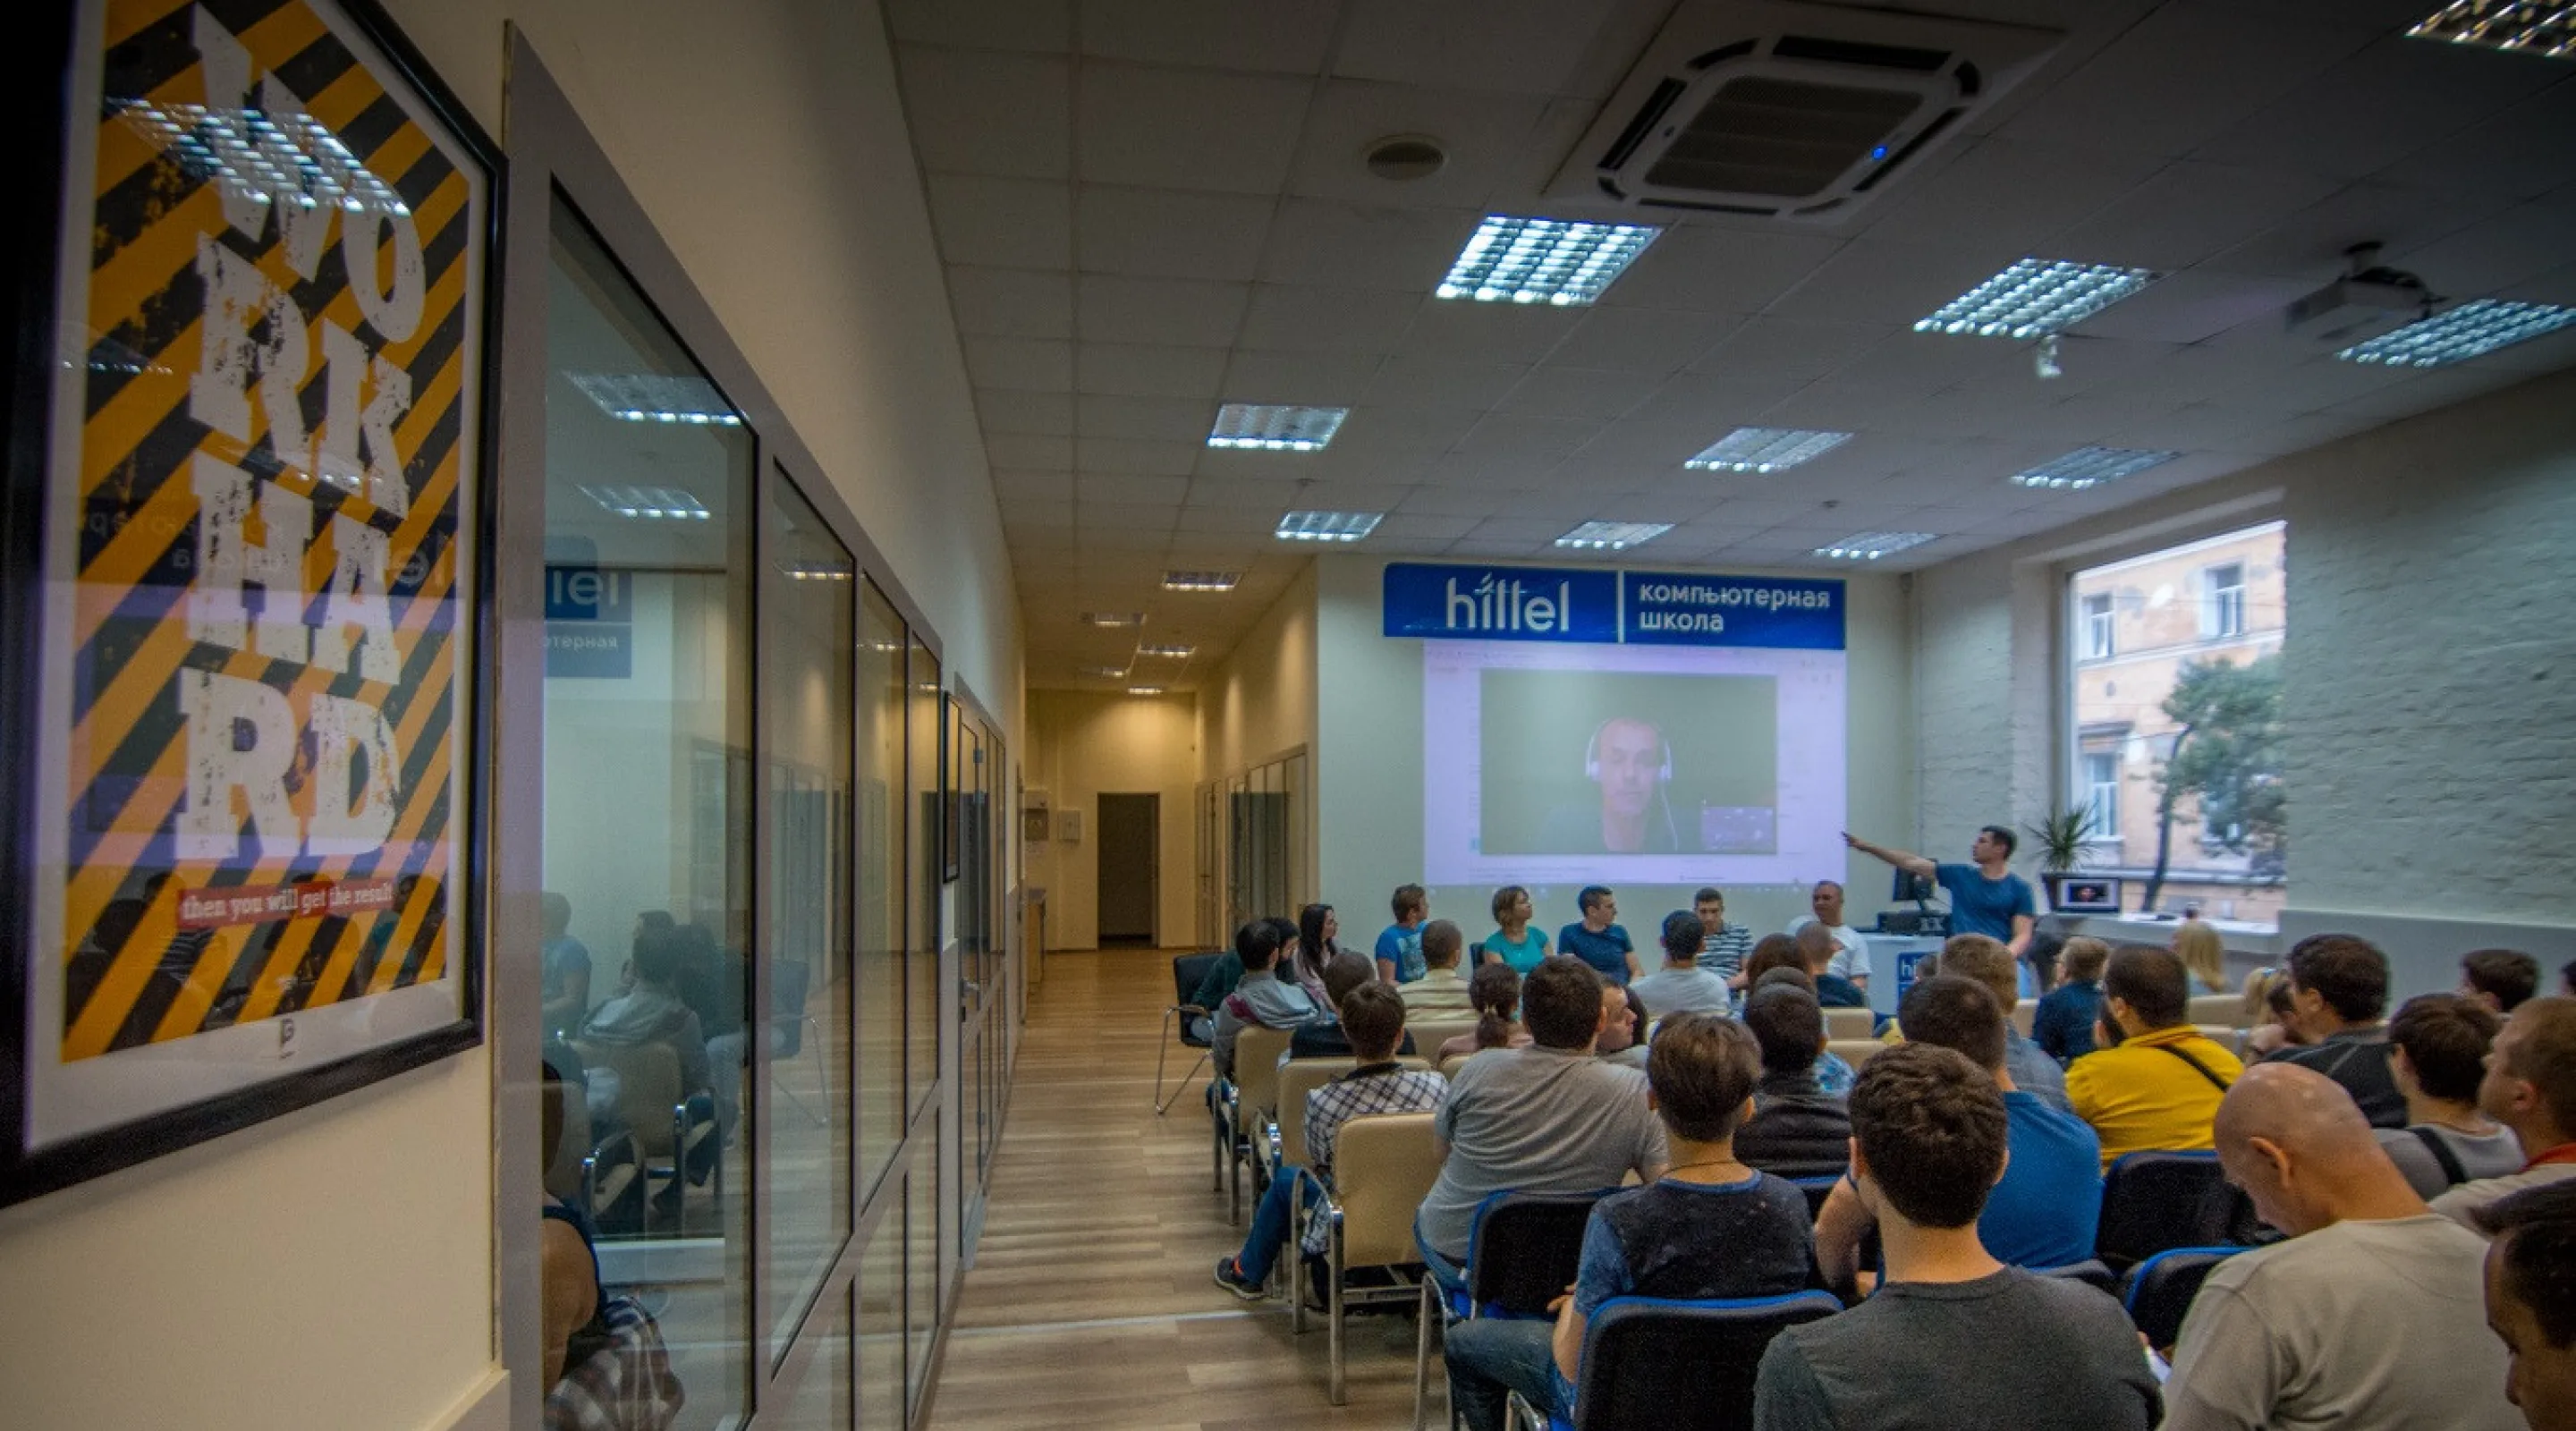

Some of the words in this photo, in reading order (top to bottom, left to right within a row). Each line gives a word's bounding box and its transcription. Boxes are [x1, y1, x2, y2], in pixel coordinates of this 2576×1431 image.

[1446, 572, 1569, 632] hillel
[1639, 584, 1831, 612] компьютерная
[1639, 611, 1724, 631] школа
[175, 667, 402, 860] RD
[182, 895, 227, 920] then
[229, 897, 263, 921] you
[267, 888, 298, 910] will
[301, 889, 327, 915] get
[329, 886, 352, 906] the
[353, 881, 392, 903] result
